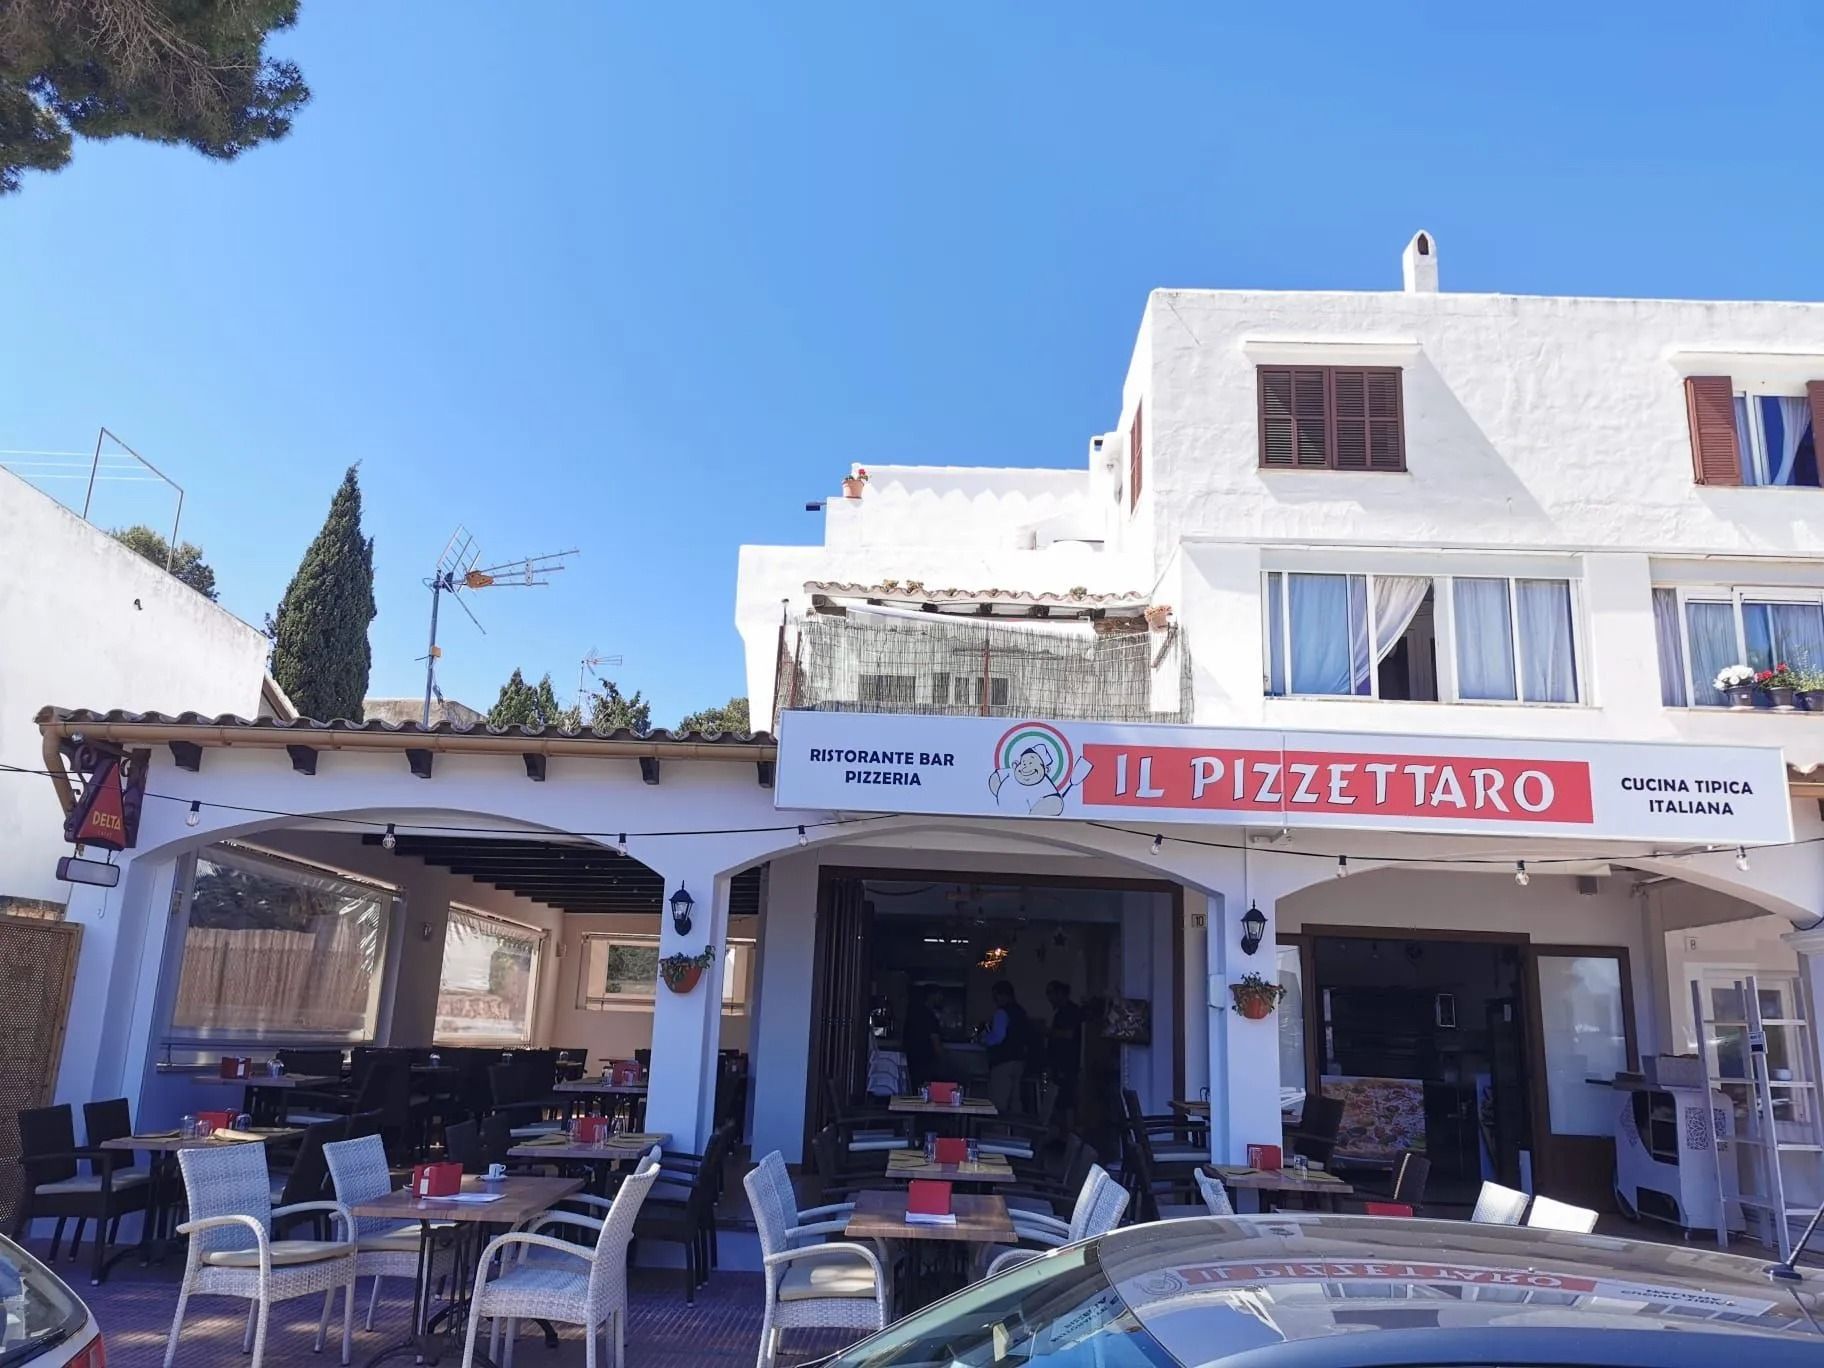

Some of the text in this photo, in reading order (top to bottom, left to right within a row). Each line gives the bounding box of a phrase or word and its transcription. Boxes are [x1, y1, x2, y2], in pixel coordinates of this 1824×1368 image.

[810, 748, 955, 766] RISTORANTE BAR
[845, 770, 922, 786] PIZZERIA
[1115, 753, 1555, 813] IL PIZZETTARO
[1621, 777, 1753, 795] CUCINA TIPICA
[1649, 799, 1734, 816] ITALIANA
[92, 810, 121, 830] DELTA
[1195, 915, 1204, 929] 10
